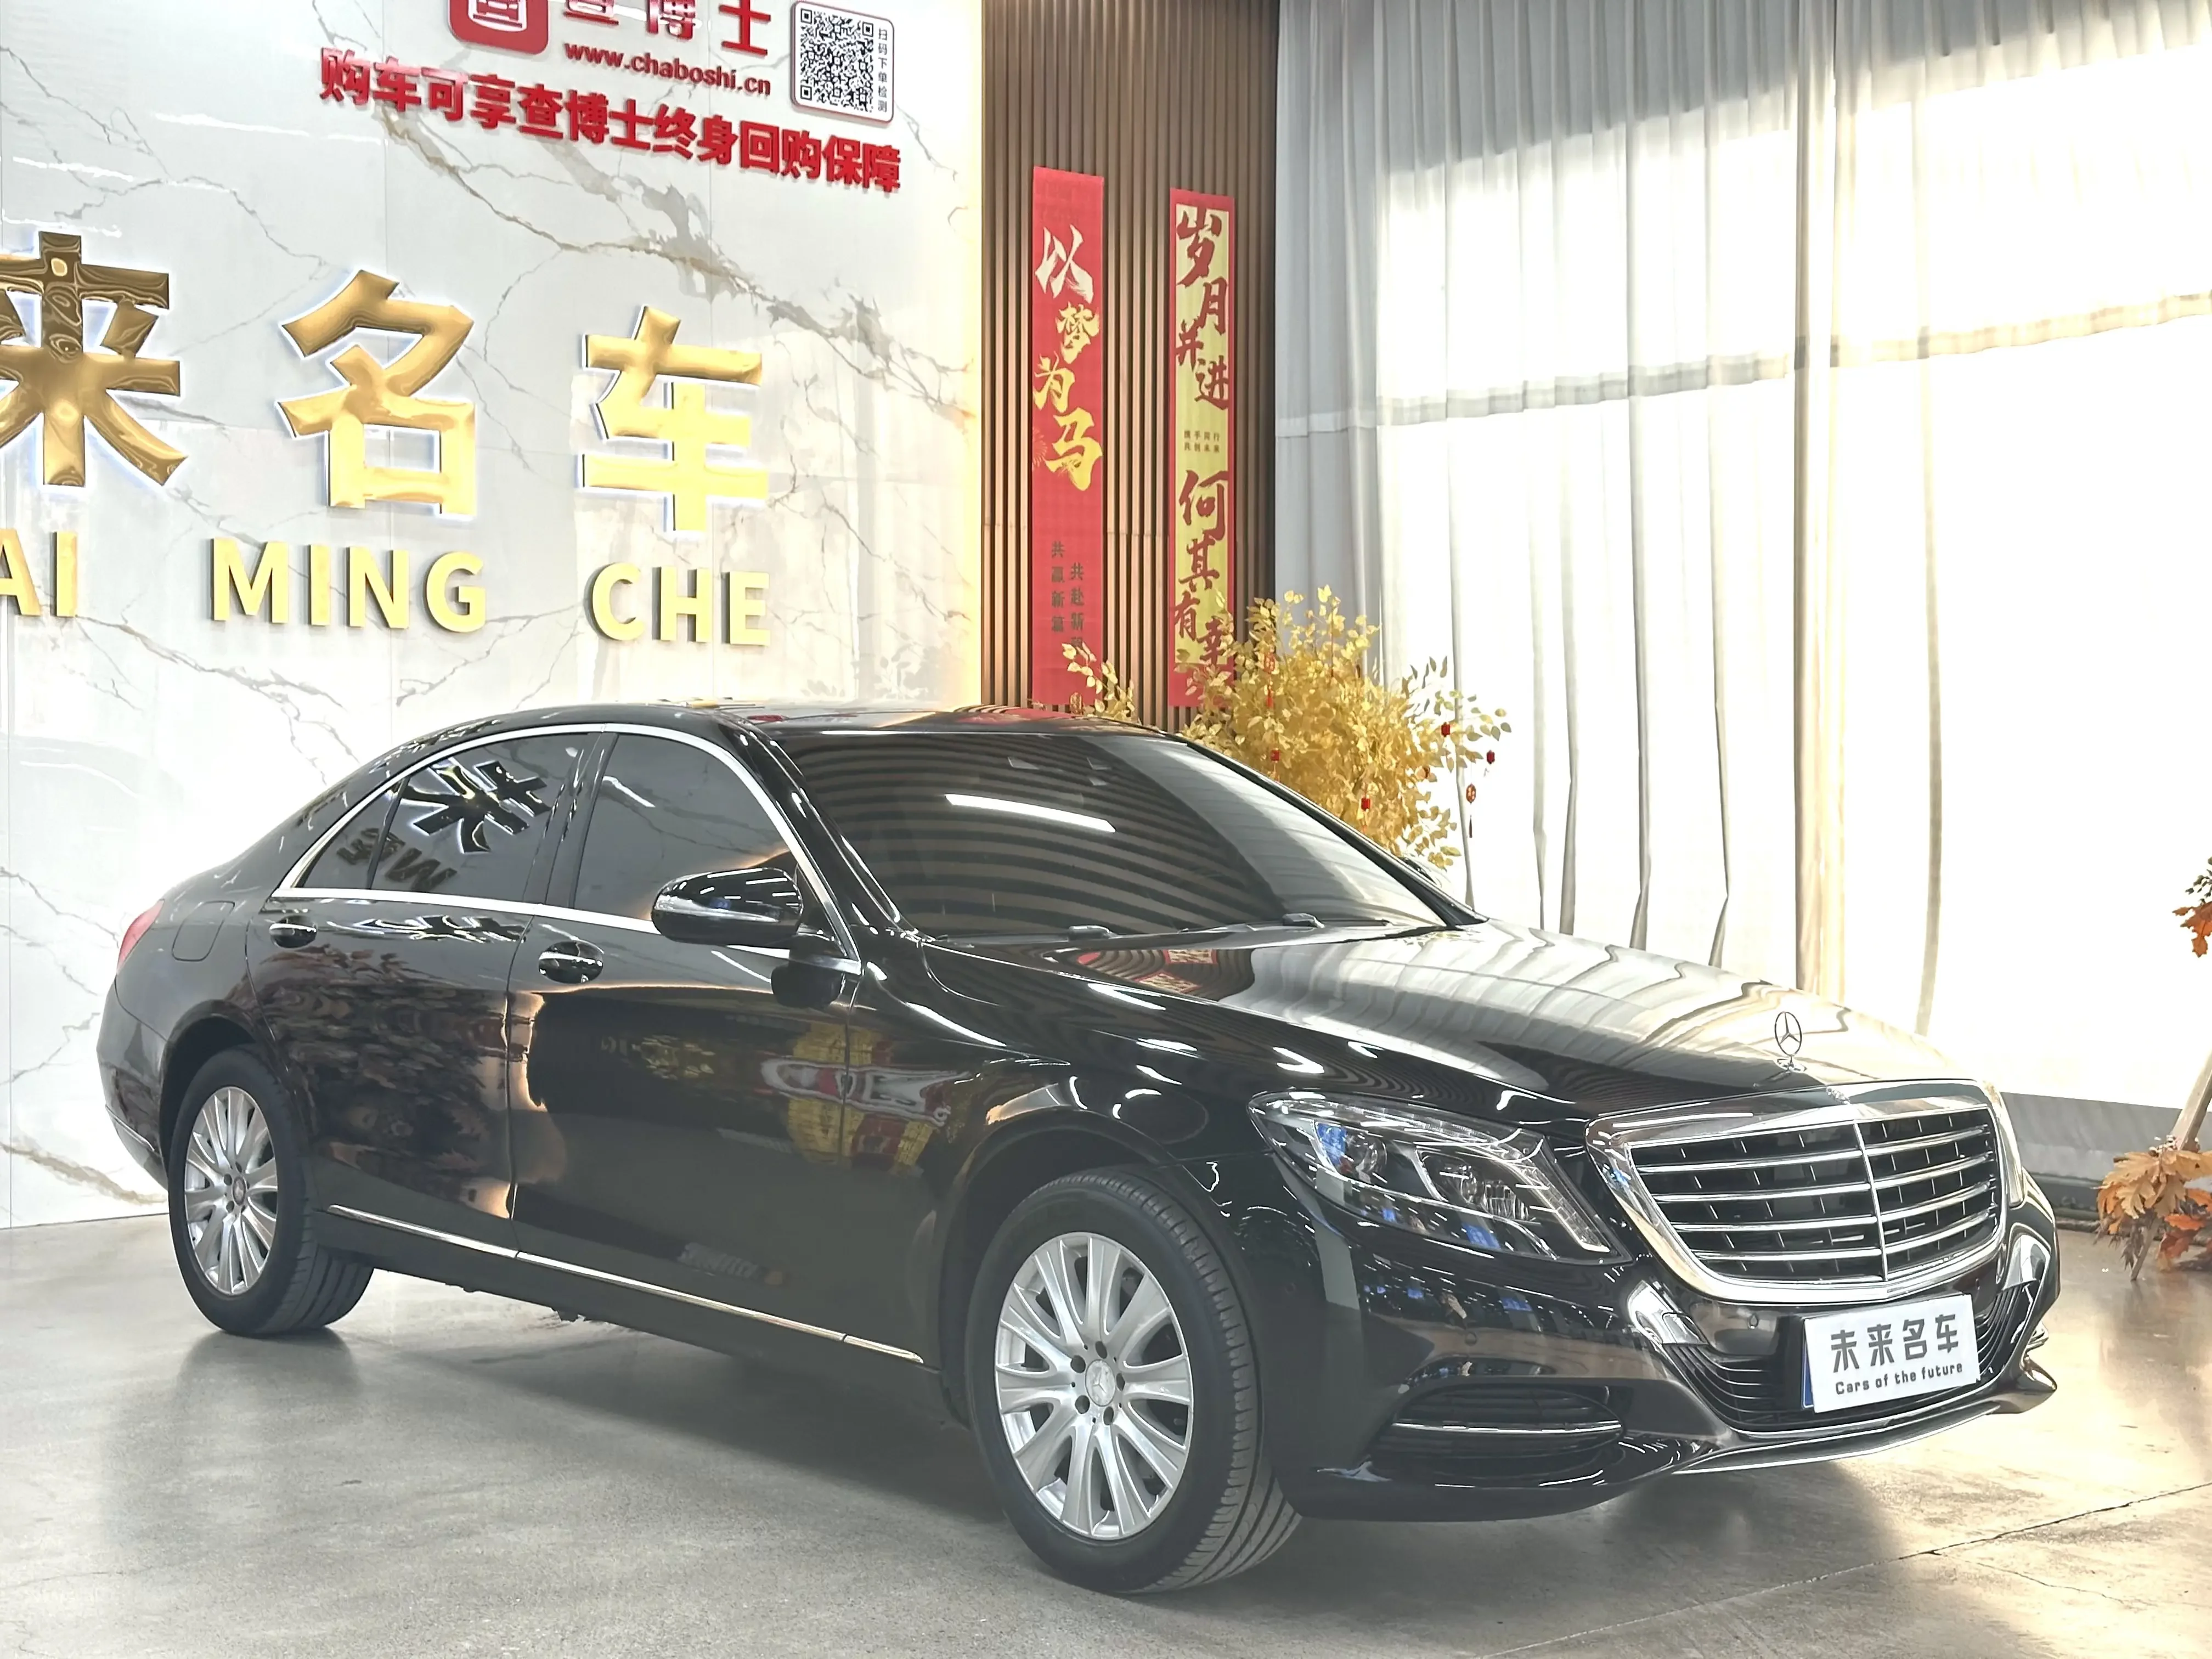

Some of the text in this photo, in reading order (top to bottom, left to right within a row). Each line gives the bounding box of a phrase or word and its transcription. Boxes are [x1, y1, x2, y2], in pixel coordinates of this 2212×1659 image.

[564, 42, 771, 95] www.chaboshi.cn
[878, 28, 888, 112] 扫码下单检测
[320, 48, 901, 194] 购车可享查博士终身回购保障
[1176, 207, 1229, 410] 岁月并进
[1034, 224, 1103, 491] 以梦为马
[210, 538, 487, 633] MING
[589, 561, 770, 646] CHE
[1831, 1313, 1959, 1373] 未来名车
[1835, 1363, 1963, 1395] Cars of the future
